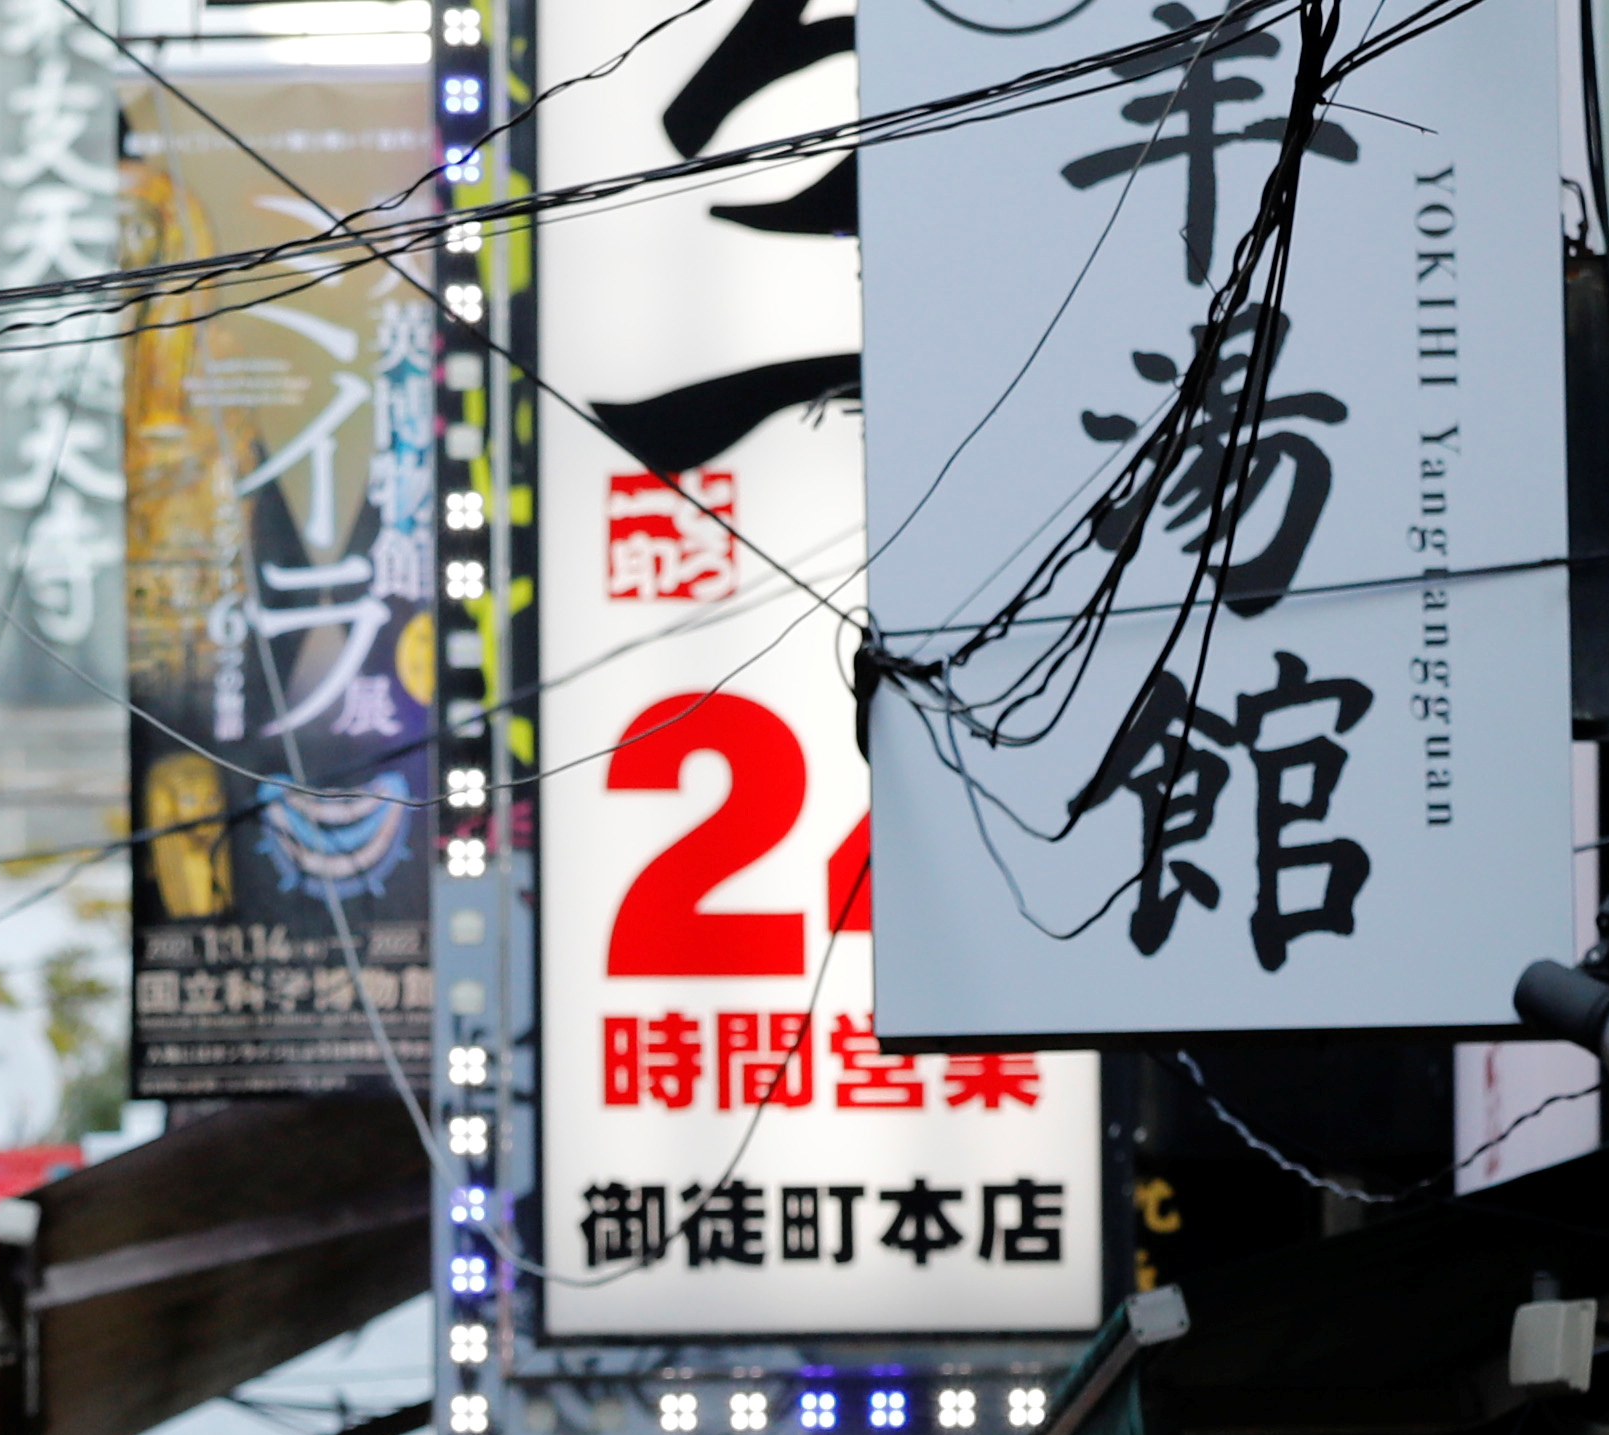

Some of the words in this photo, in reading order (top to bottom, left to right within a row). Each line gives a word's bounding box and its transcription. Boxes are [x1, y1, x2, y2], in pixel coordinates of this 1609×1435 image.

[1414, 165, 1458, 386] YOKIHI
[1061, 2, 1375, 972] 羊湯館
[581, 1179, 1065, 1268] 御徒町本店
